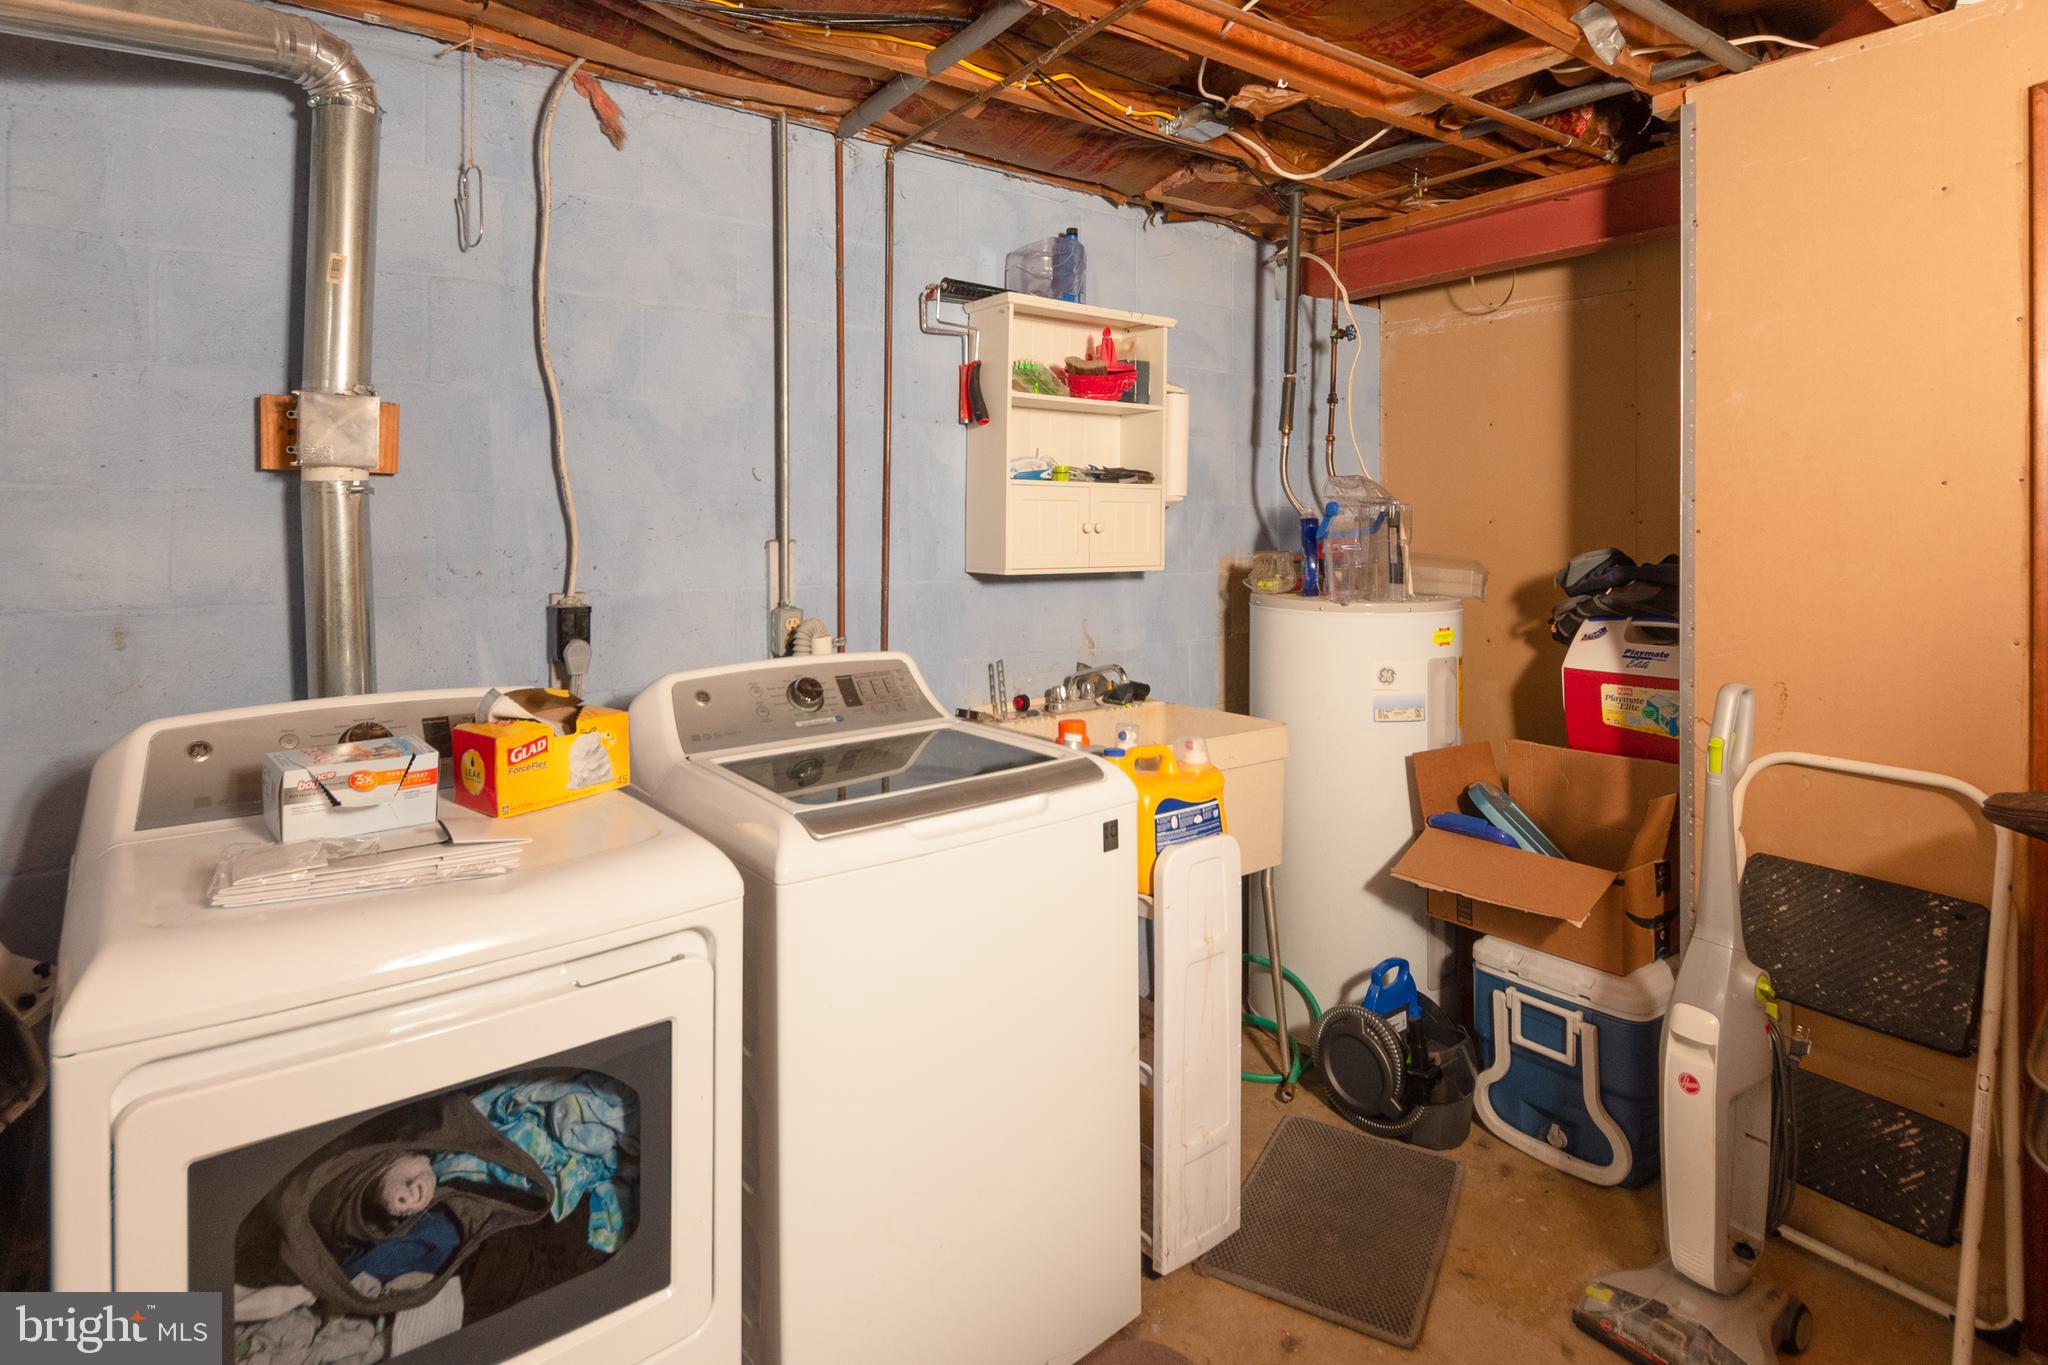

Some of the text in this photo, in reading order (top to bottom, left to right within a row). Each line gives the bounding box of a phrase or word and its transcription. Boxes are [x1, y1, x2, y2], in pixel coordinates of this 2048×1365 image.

[1623, 648, 1671, 659] Playmate
[1605, 694, 1645, 705] Playmate
[1619, 703, 1640, 712] Elite
[510, 737, 547, 763] GLAD
[465, 767, 481, 778] LEAK
[616, 775, 628, 785] 45
